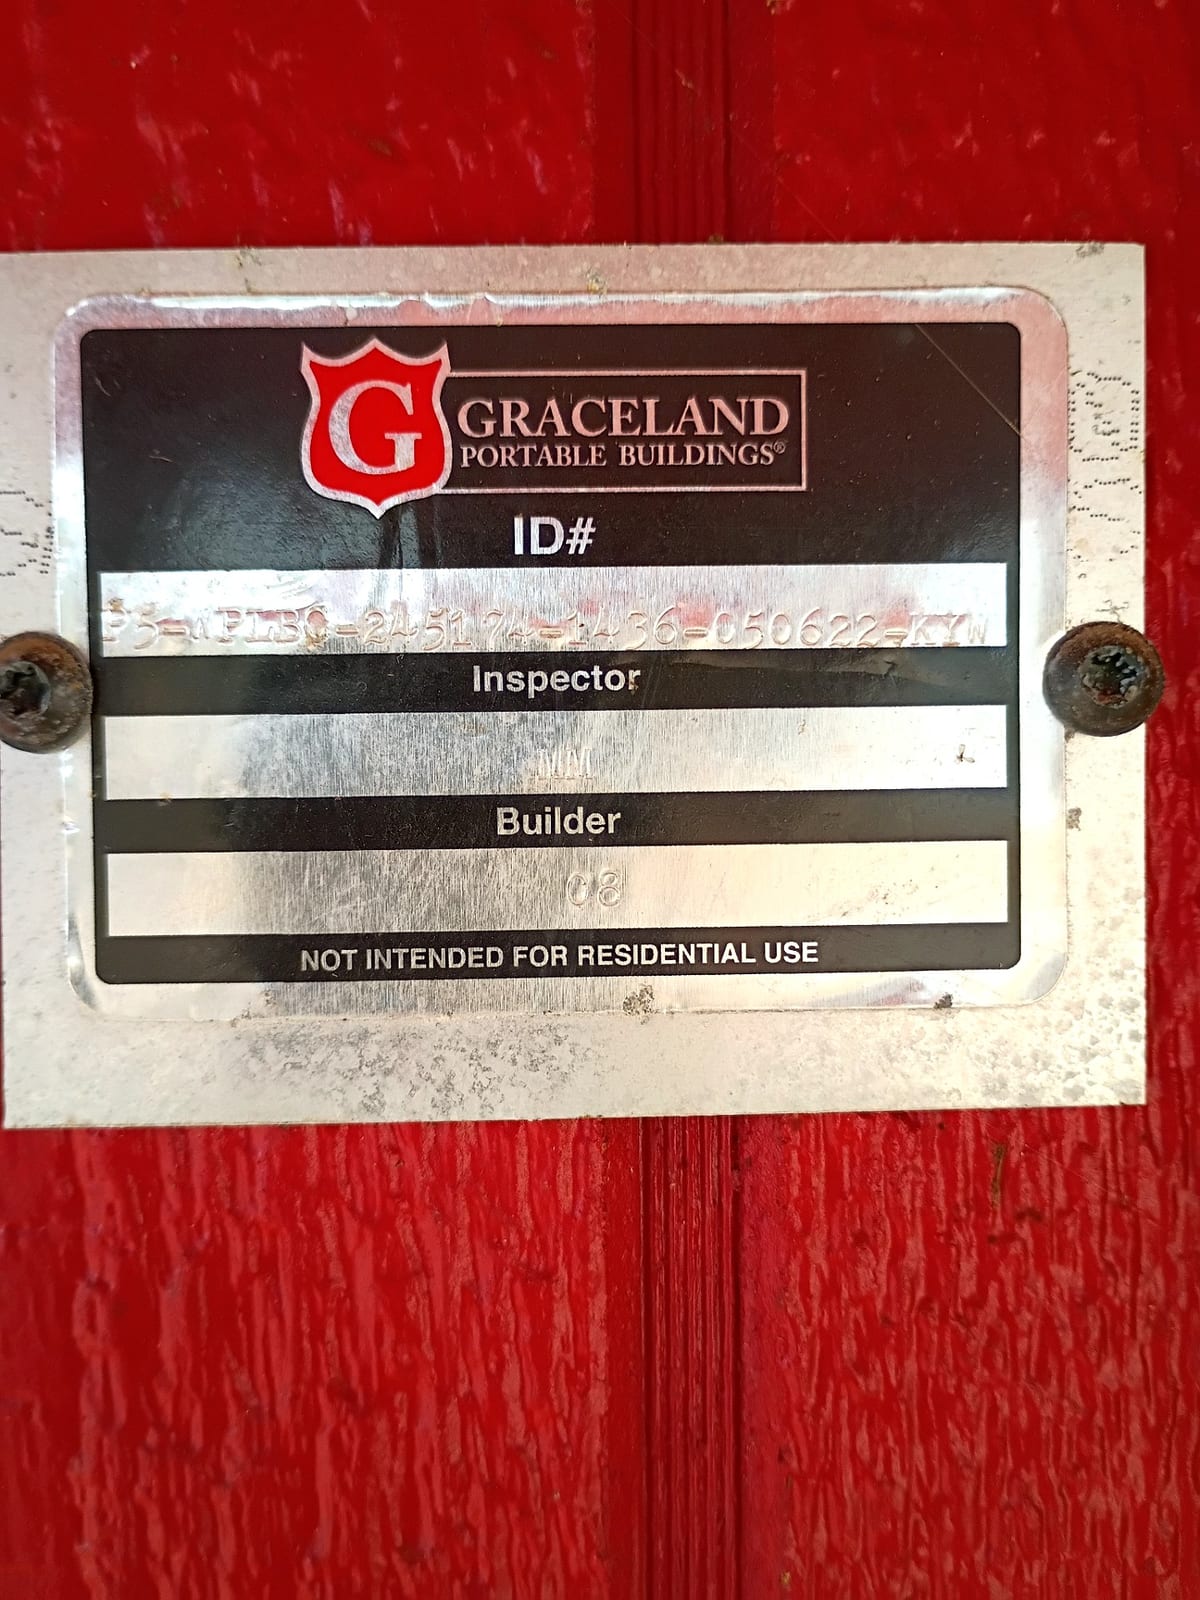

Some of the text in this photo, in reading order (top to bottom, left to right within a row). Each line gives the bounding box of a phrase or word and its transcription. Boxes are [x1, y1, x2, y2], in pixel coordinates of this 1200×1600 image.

[328, 379, 423, 476] G
[457, 396, 790, 439] GRACELAND
[460, 443, 607, 468] PORTABLE
[513, 515, 597, 557] ID#
[472, 664, 642, 699] Inspector
[496, 806, 622, 836] Builder
[565, 868, 621, 907] 08
[300, 940, 819, 973] NOT INTENDED FOR RESIDENTIAL USE
